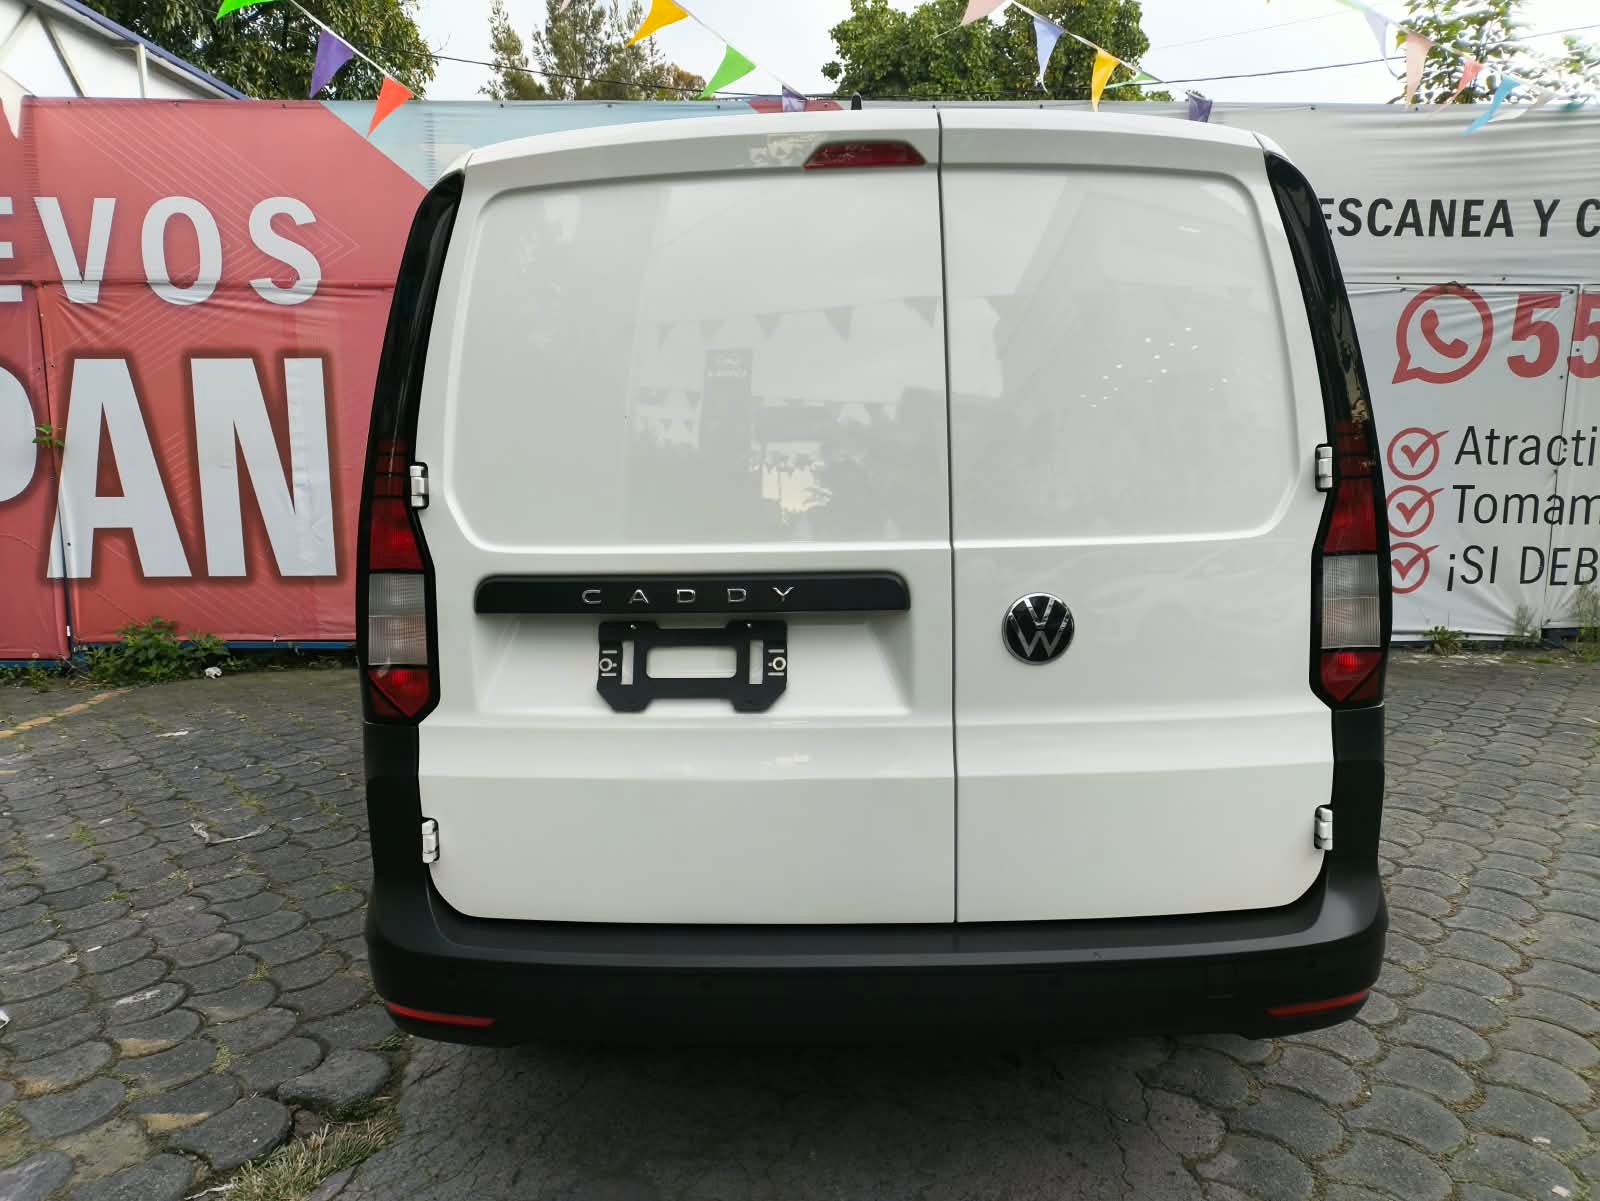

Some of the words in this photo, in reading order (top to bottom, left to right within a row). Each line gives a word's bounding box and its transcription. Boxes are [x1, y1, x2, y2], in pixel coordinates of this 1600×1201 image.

[1533, 199, 1561, 238] Y
[1507, 292, 1600, 379] 55
[1454, 425, 1598, 467] Atracti
[1452, 484, 1600, 525] Tomam
[1519, 545, 1600, 586] DEB
[581, 586, 795, 604] CADDY
[1003, 592, 1075, 665] VW
